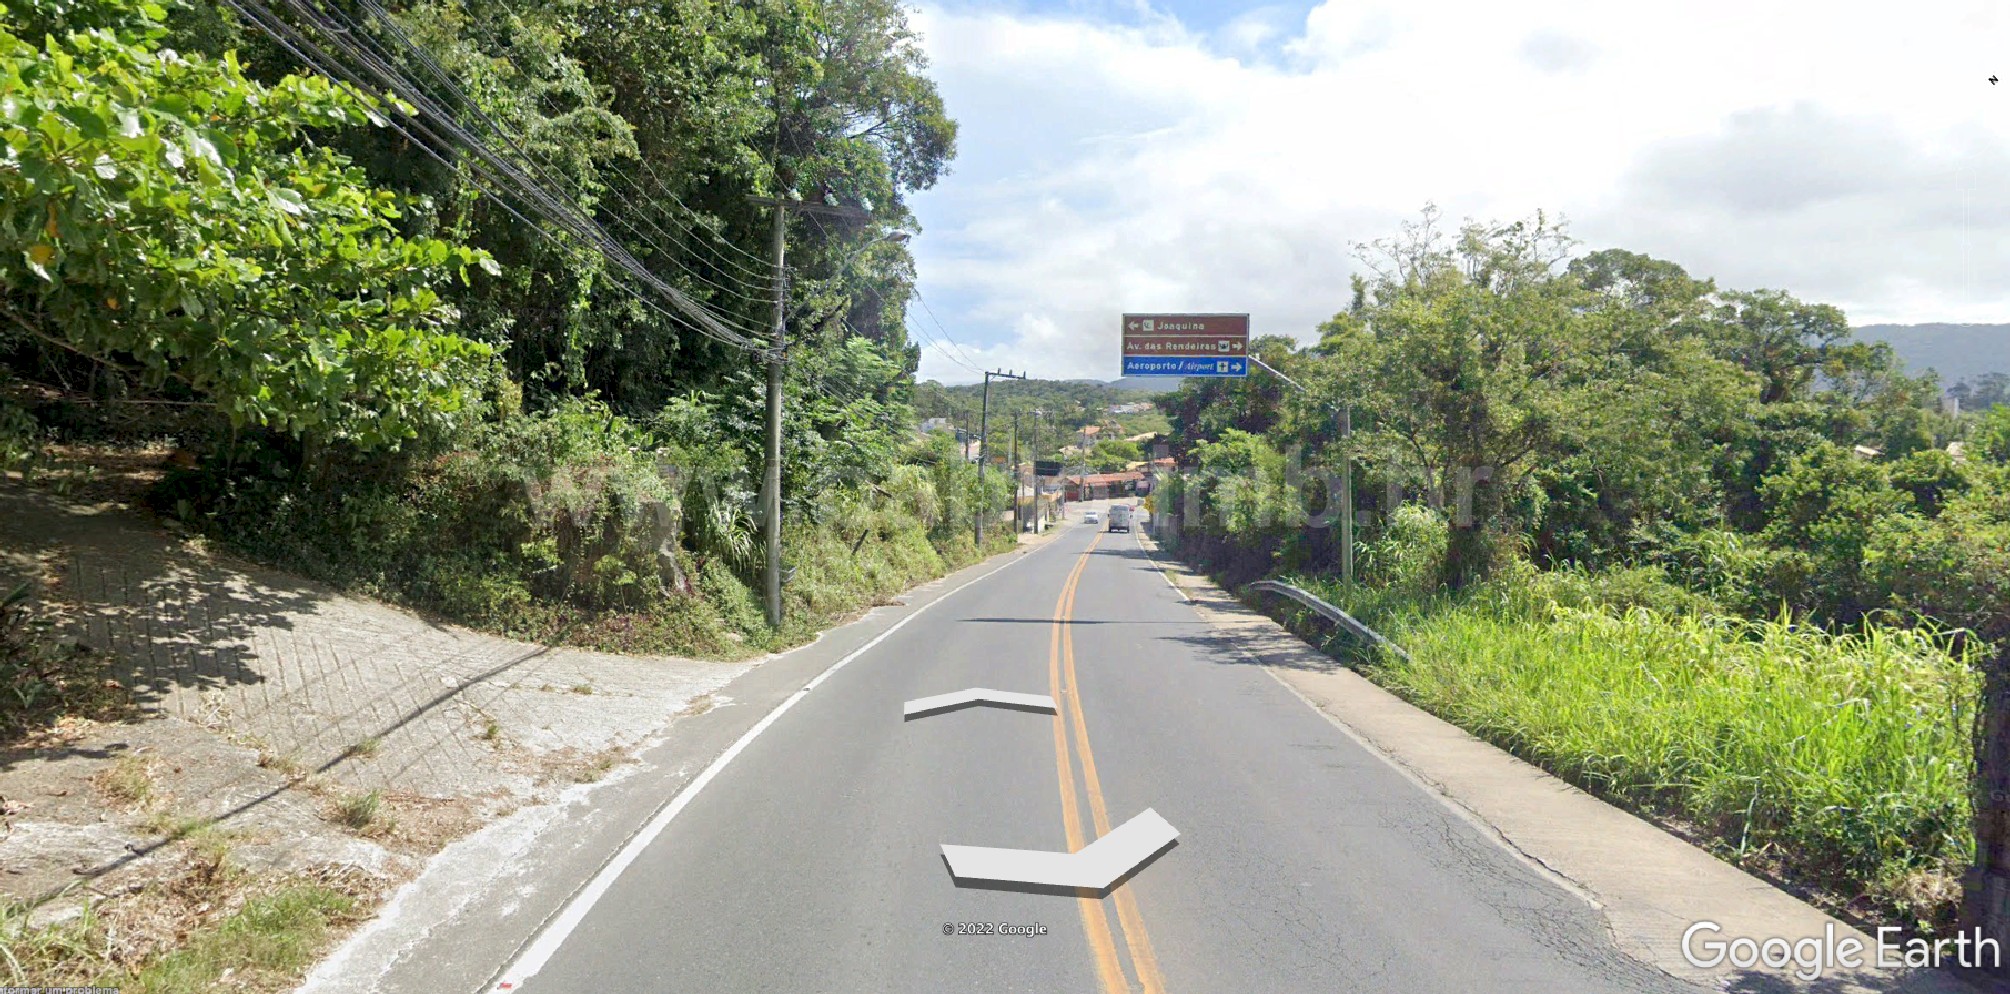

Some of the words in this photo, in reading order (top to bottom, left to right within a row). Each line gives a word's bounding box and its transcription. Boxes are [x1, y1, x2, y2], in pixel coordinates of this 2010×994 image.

[1157, 321, 1206, 332] Joaquina
[1126, 341, 1142, 350] Av.
[1144, 341, 1162, 350] das
[1165, 341, 1217, 350] Rendeiras
